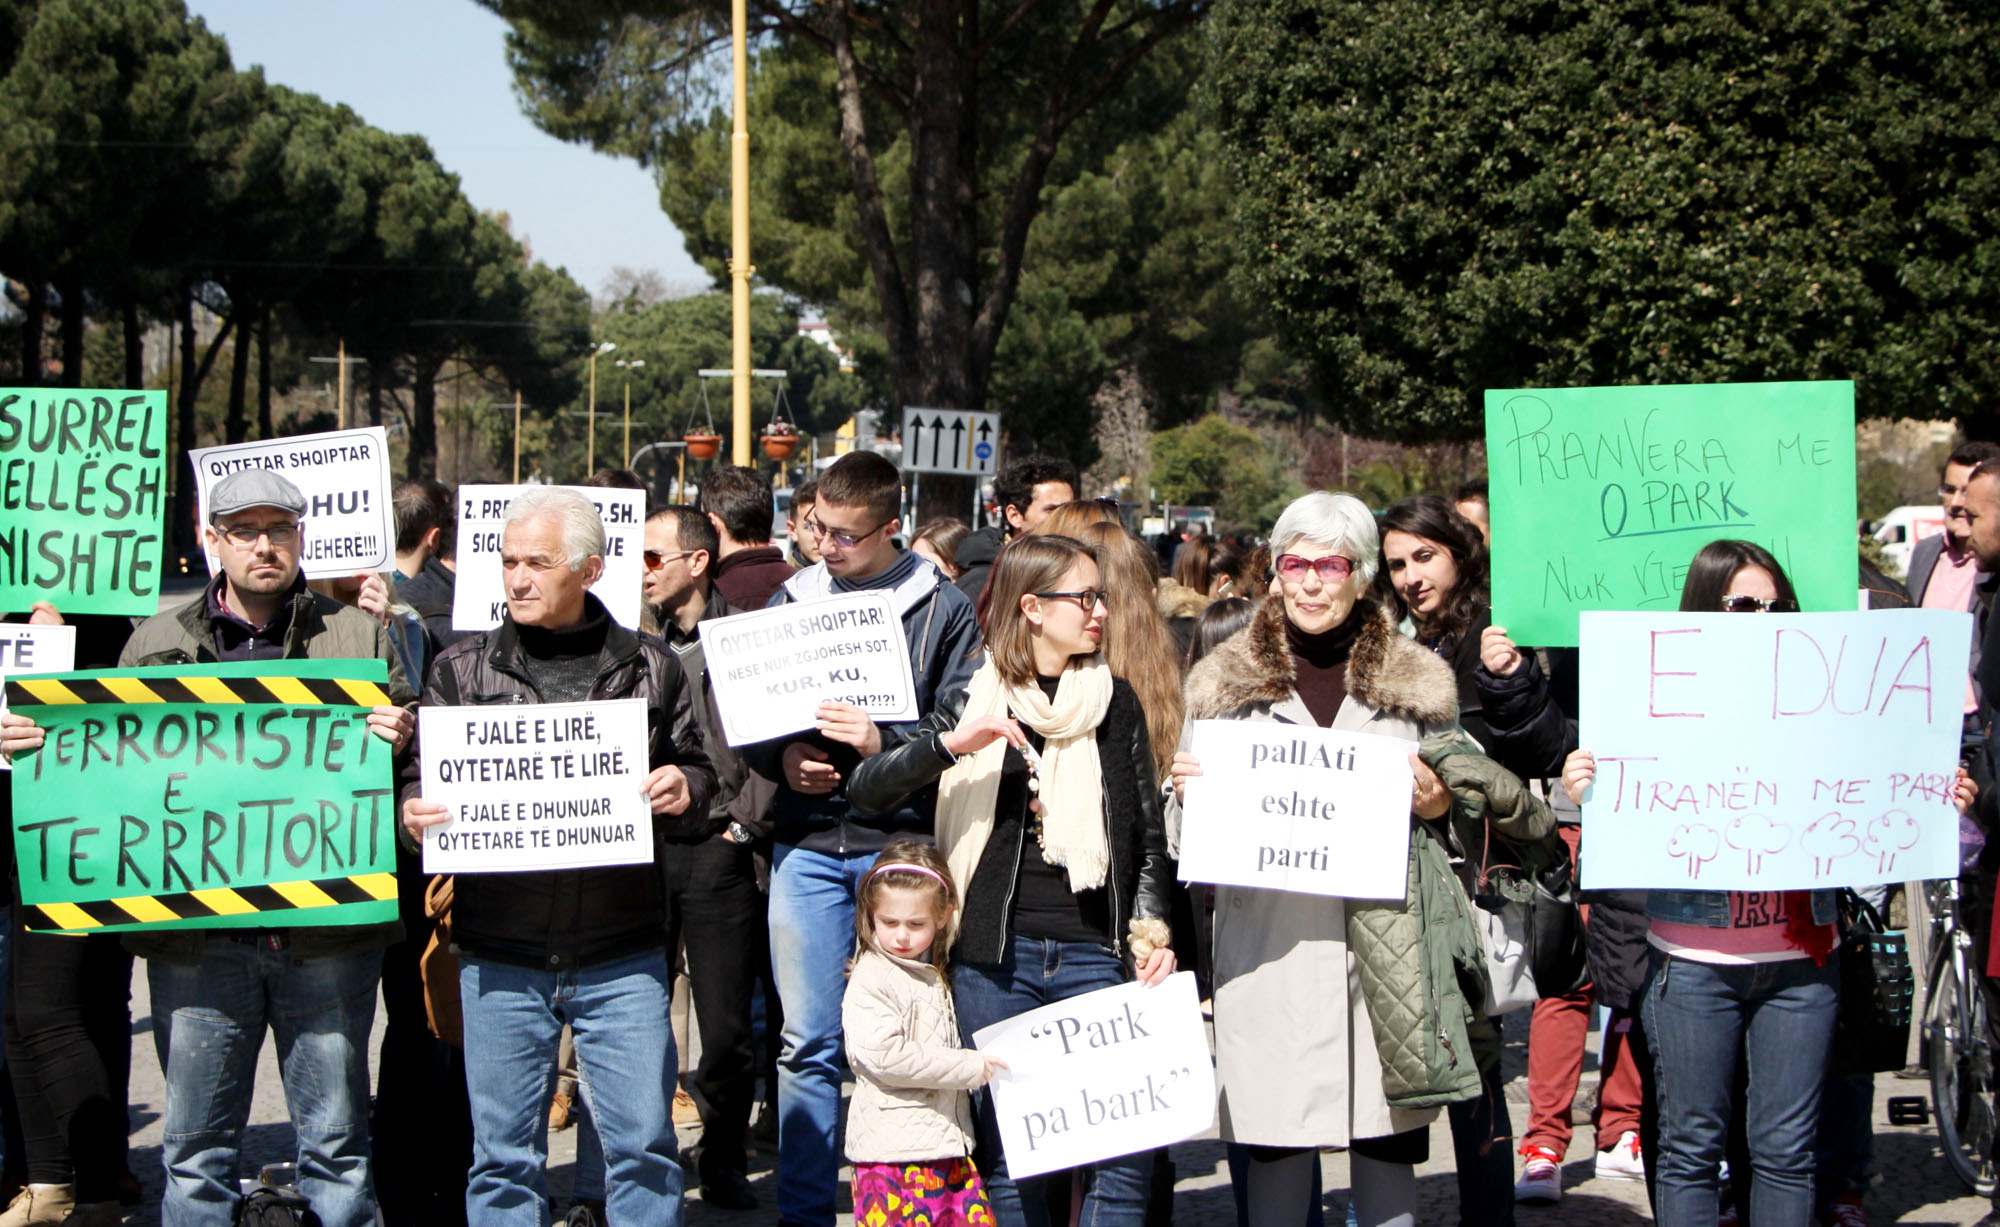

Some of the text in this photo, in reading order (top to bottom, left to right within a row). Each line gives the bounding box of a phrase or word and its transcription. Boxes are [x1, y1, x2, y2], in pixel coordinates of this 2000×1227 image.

[0, 394, 160, 459] SURREL
[210, 444, 371, 476] QYTETAR SHQIPTAR
[1777, 433, 1833, 466] ME
[0, 452, 161, 520] ELLËSH
[312, 489, 369, 517] HU!
[1641, 480, 1749, 529] PARK
[300, 531, 377, 560] JËHERË!!!
[1633, 551, 1692, 608] VJE
[720, 607, 885, 656] QYTETAR SHQIPTAR!
[728, 639, 893, 681] NESE NUK ZGJOHESH SOT,
[1648, 628, 1932, 724] E DUA
[766, 667, 868, 696] KUR, KU,
[34, 709, 375, 781] TERRORISTËT
[466, 711, 601, 745] FJALË E LIRË,
[439, 746, 630, 784] QYTETARË TË LIRË.
[1250, 739, 1356, 772] pallAti
[164, 773, 196, 813] E
[1597, 756, 1957, 815] TIRANËN ME PARK
[460, 797, 612, 822] FJALË E DHUNUAR
[1261, 791, 1336, 821] eshte
[18, 789, 393, 890] TERRRITORIT
[438, 823, 636, 851] QYTETARË TË DHUNUAR
[1257, 845, 1329, 872] parti
[1022, 1106, 1070, 1151] pa
